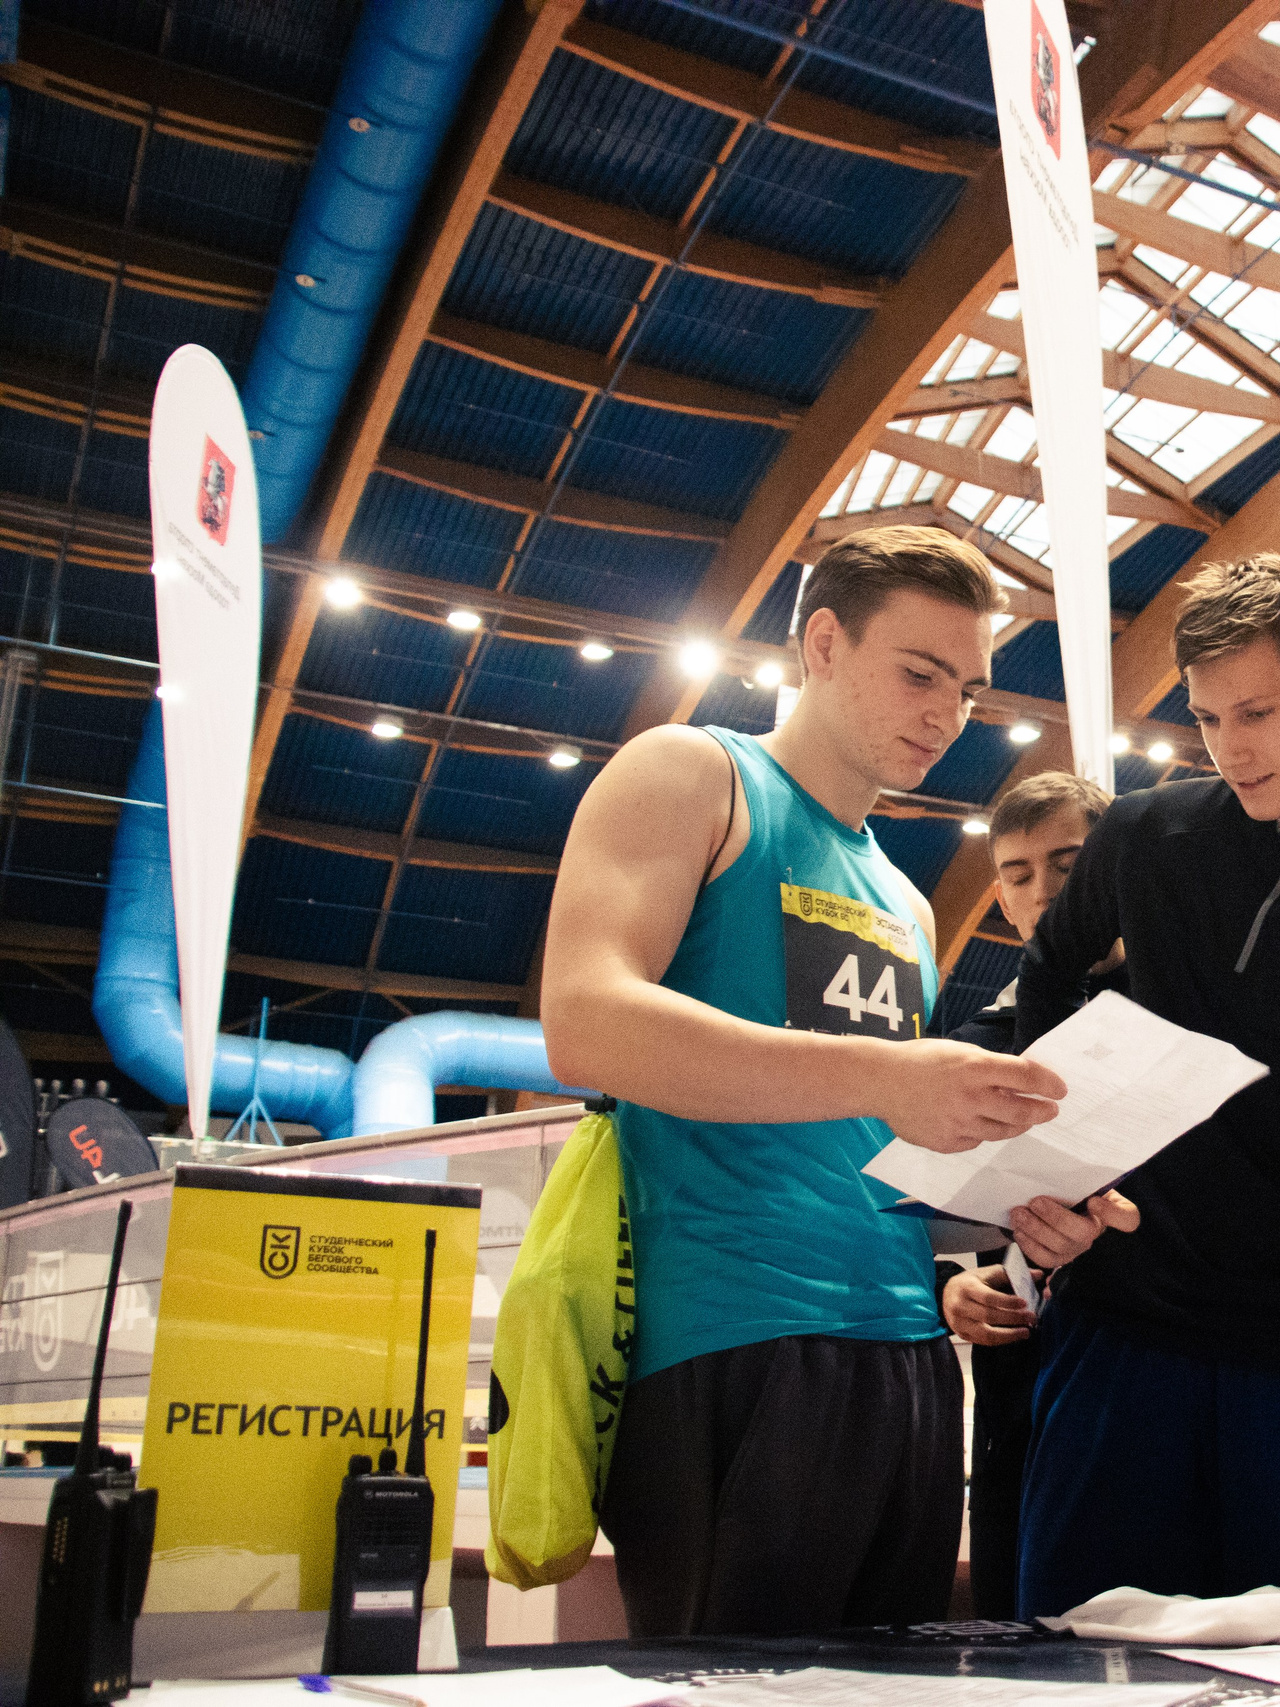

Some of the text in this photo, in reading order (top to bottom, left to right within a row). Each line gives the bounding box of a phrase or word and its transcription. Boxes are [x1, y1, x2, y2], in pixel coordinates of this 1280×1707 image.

[815, 898, 867, 918] СТУДЕНЧЕСКИЙ
[815, 907, 838, 918] КУБОК
[823, 953, 903, 1032] 44
[309, 1235, 394, 1248] СТУДЕНЧЕСКИЙ
[308, 1244, 345, 1254] КУБОК
[308, 1254, 363, 1265] БЕГОВОГО
[307, 1263, 379, 1275] СООБЩЕСТВА
[165, 1401, 446, 1446] РЕГИСТРАЦИЯ
